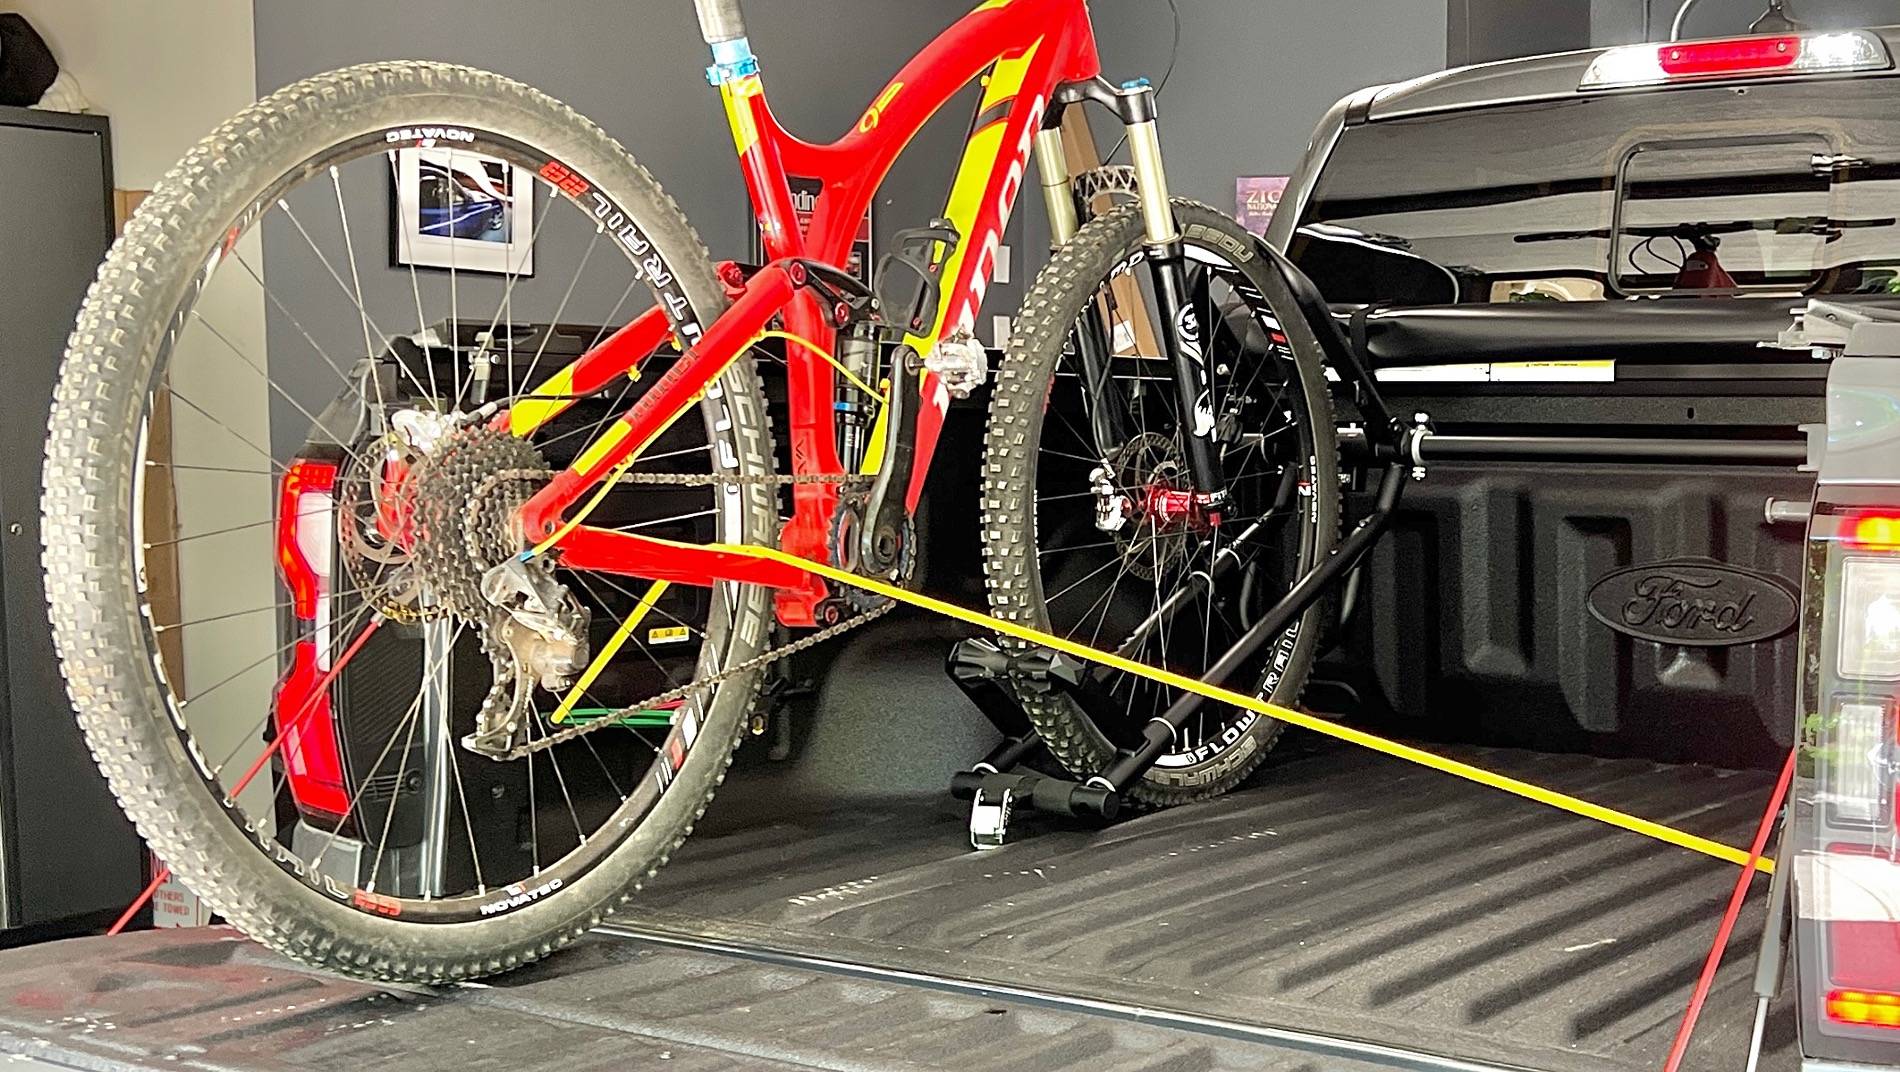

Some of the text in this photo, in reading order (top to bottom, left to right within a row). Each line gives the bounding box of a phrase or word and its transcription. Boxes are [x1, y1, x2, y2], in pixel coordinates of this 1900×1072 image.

[385, 127, 475, 143] NOVATEC
[1246, 190, 1283, 204] ZIO
[592, 191, 688, 321] TRAIL
[726, 362, 771, 649] SCHWABE
[1621, 573, 1757, 633] Ford
[1194, 708, 1256, 763] FLOW
[480, 878, 563, 915] NOVATEC
